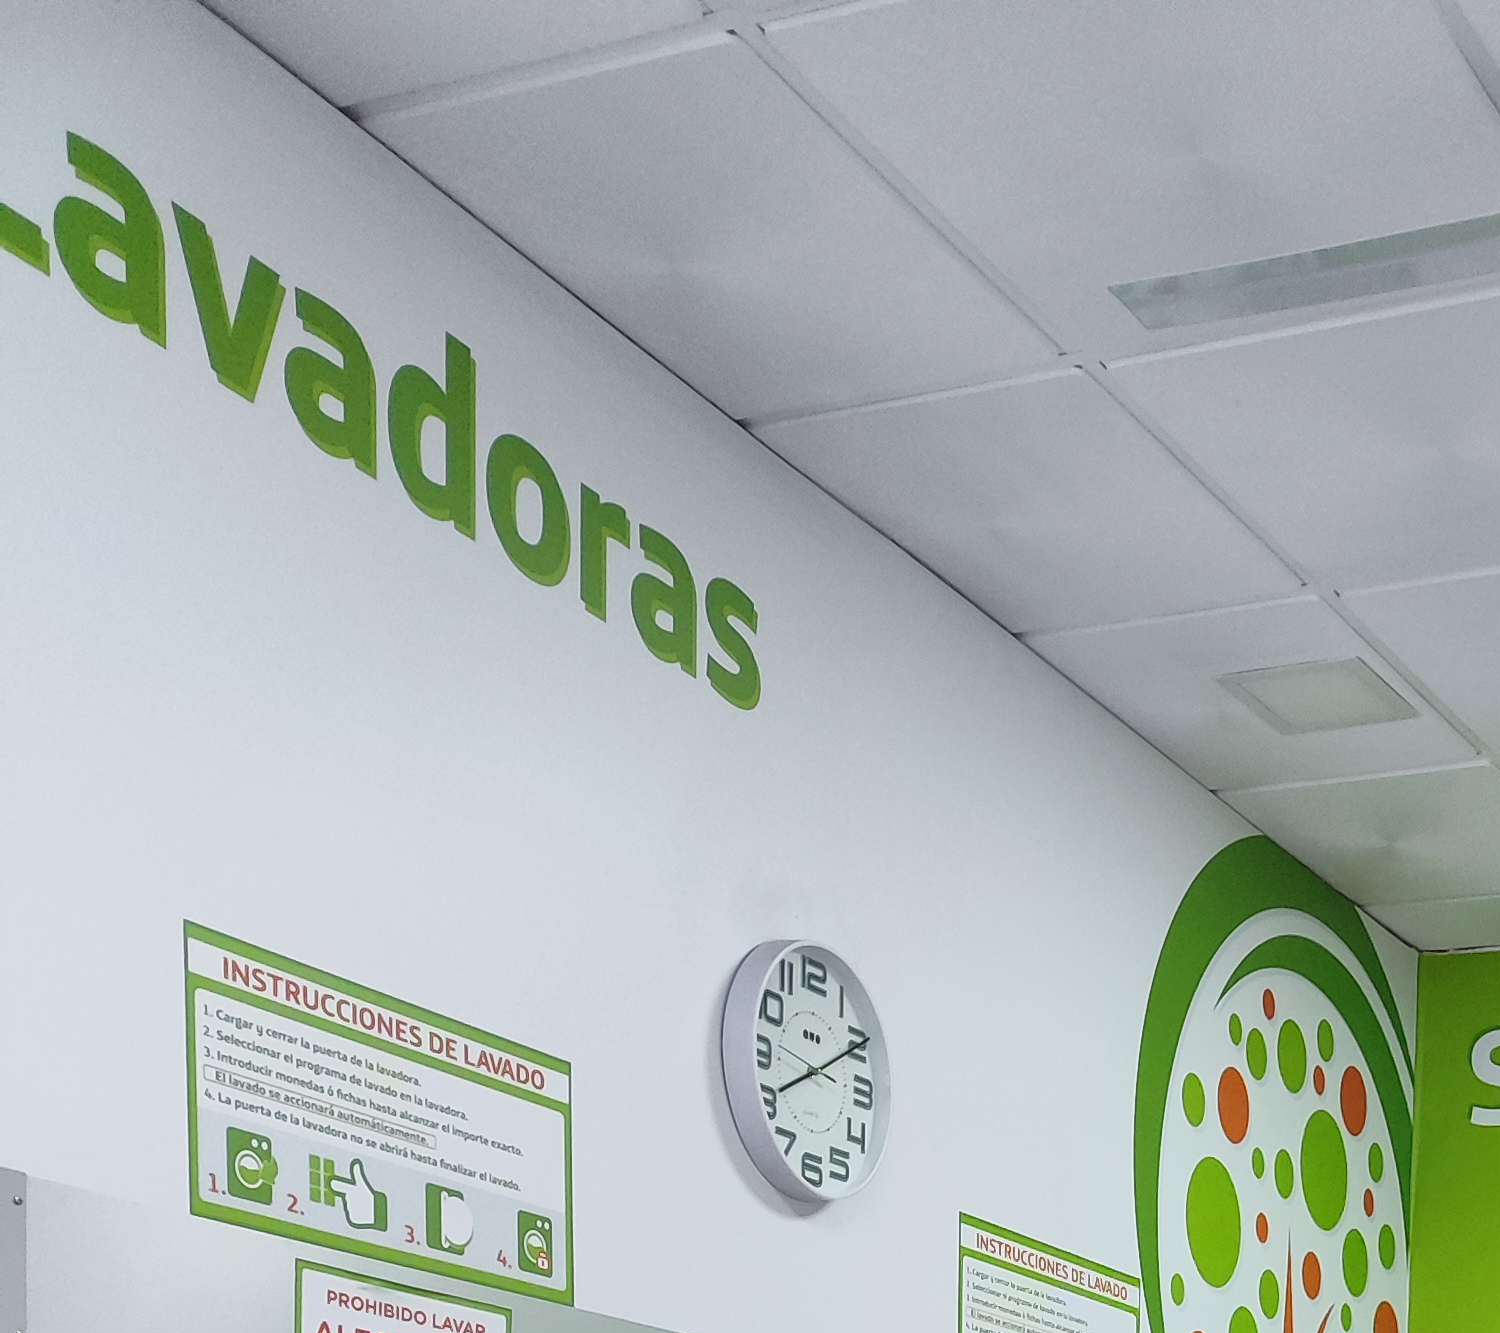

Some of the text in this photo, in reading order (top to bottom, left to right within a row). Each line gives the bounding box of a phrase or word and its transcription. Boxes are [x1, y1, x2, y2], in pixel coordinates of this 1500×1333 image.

[0, 131, 761, 711] avadoras
[779, 958, 793, 995] 11
[801, 954, 827, 997] 12
[839, 985, 844, 1018] 1
[203, 1004, 421, 1087] 1. Cargar y cerrar la puerta de la lavadora.
[223, 957, 545, 1090] INSTRUCCIONES DE LAVADO
[203, 1025, 468, 1121] 2. Seleccionar el programa de lavado en la lavadora.
[853, 1073, 873, 1111] 3
[203, 1046, 523, 1156] 3. Introducir monedas ó fichas hasta alcanzar el importe exacto.
[215, 1071, 429, 1146] El lavado se accionará automáticamente.
[204, 1088, 521, 1192] 4. La puerta de la lavadora no se abrirá hasta finalizar el lavado.
[847, 1117, 865, 1154] 4
[801, 1151, 822, 1187] 6
[829, 1145, 850, 1182] 5
[976, 1233, 1127, 1300] INSTRUCCIONES DE LAVADO
[327, 1289, 427, 1325] PROHIBIDO
